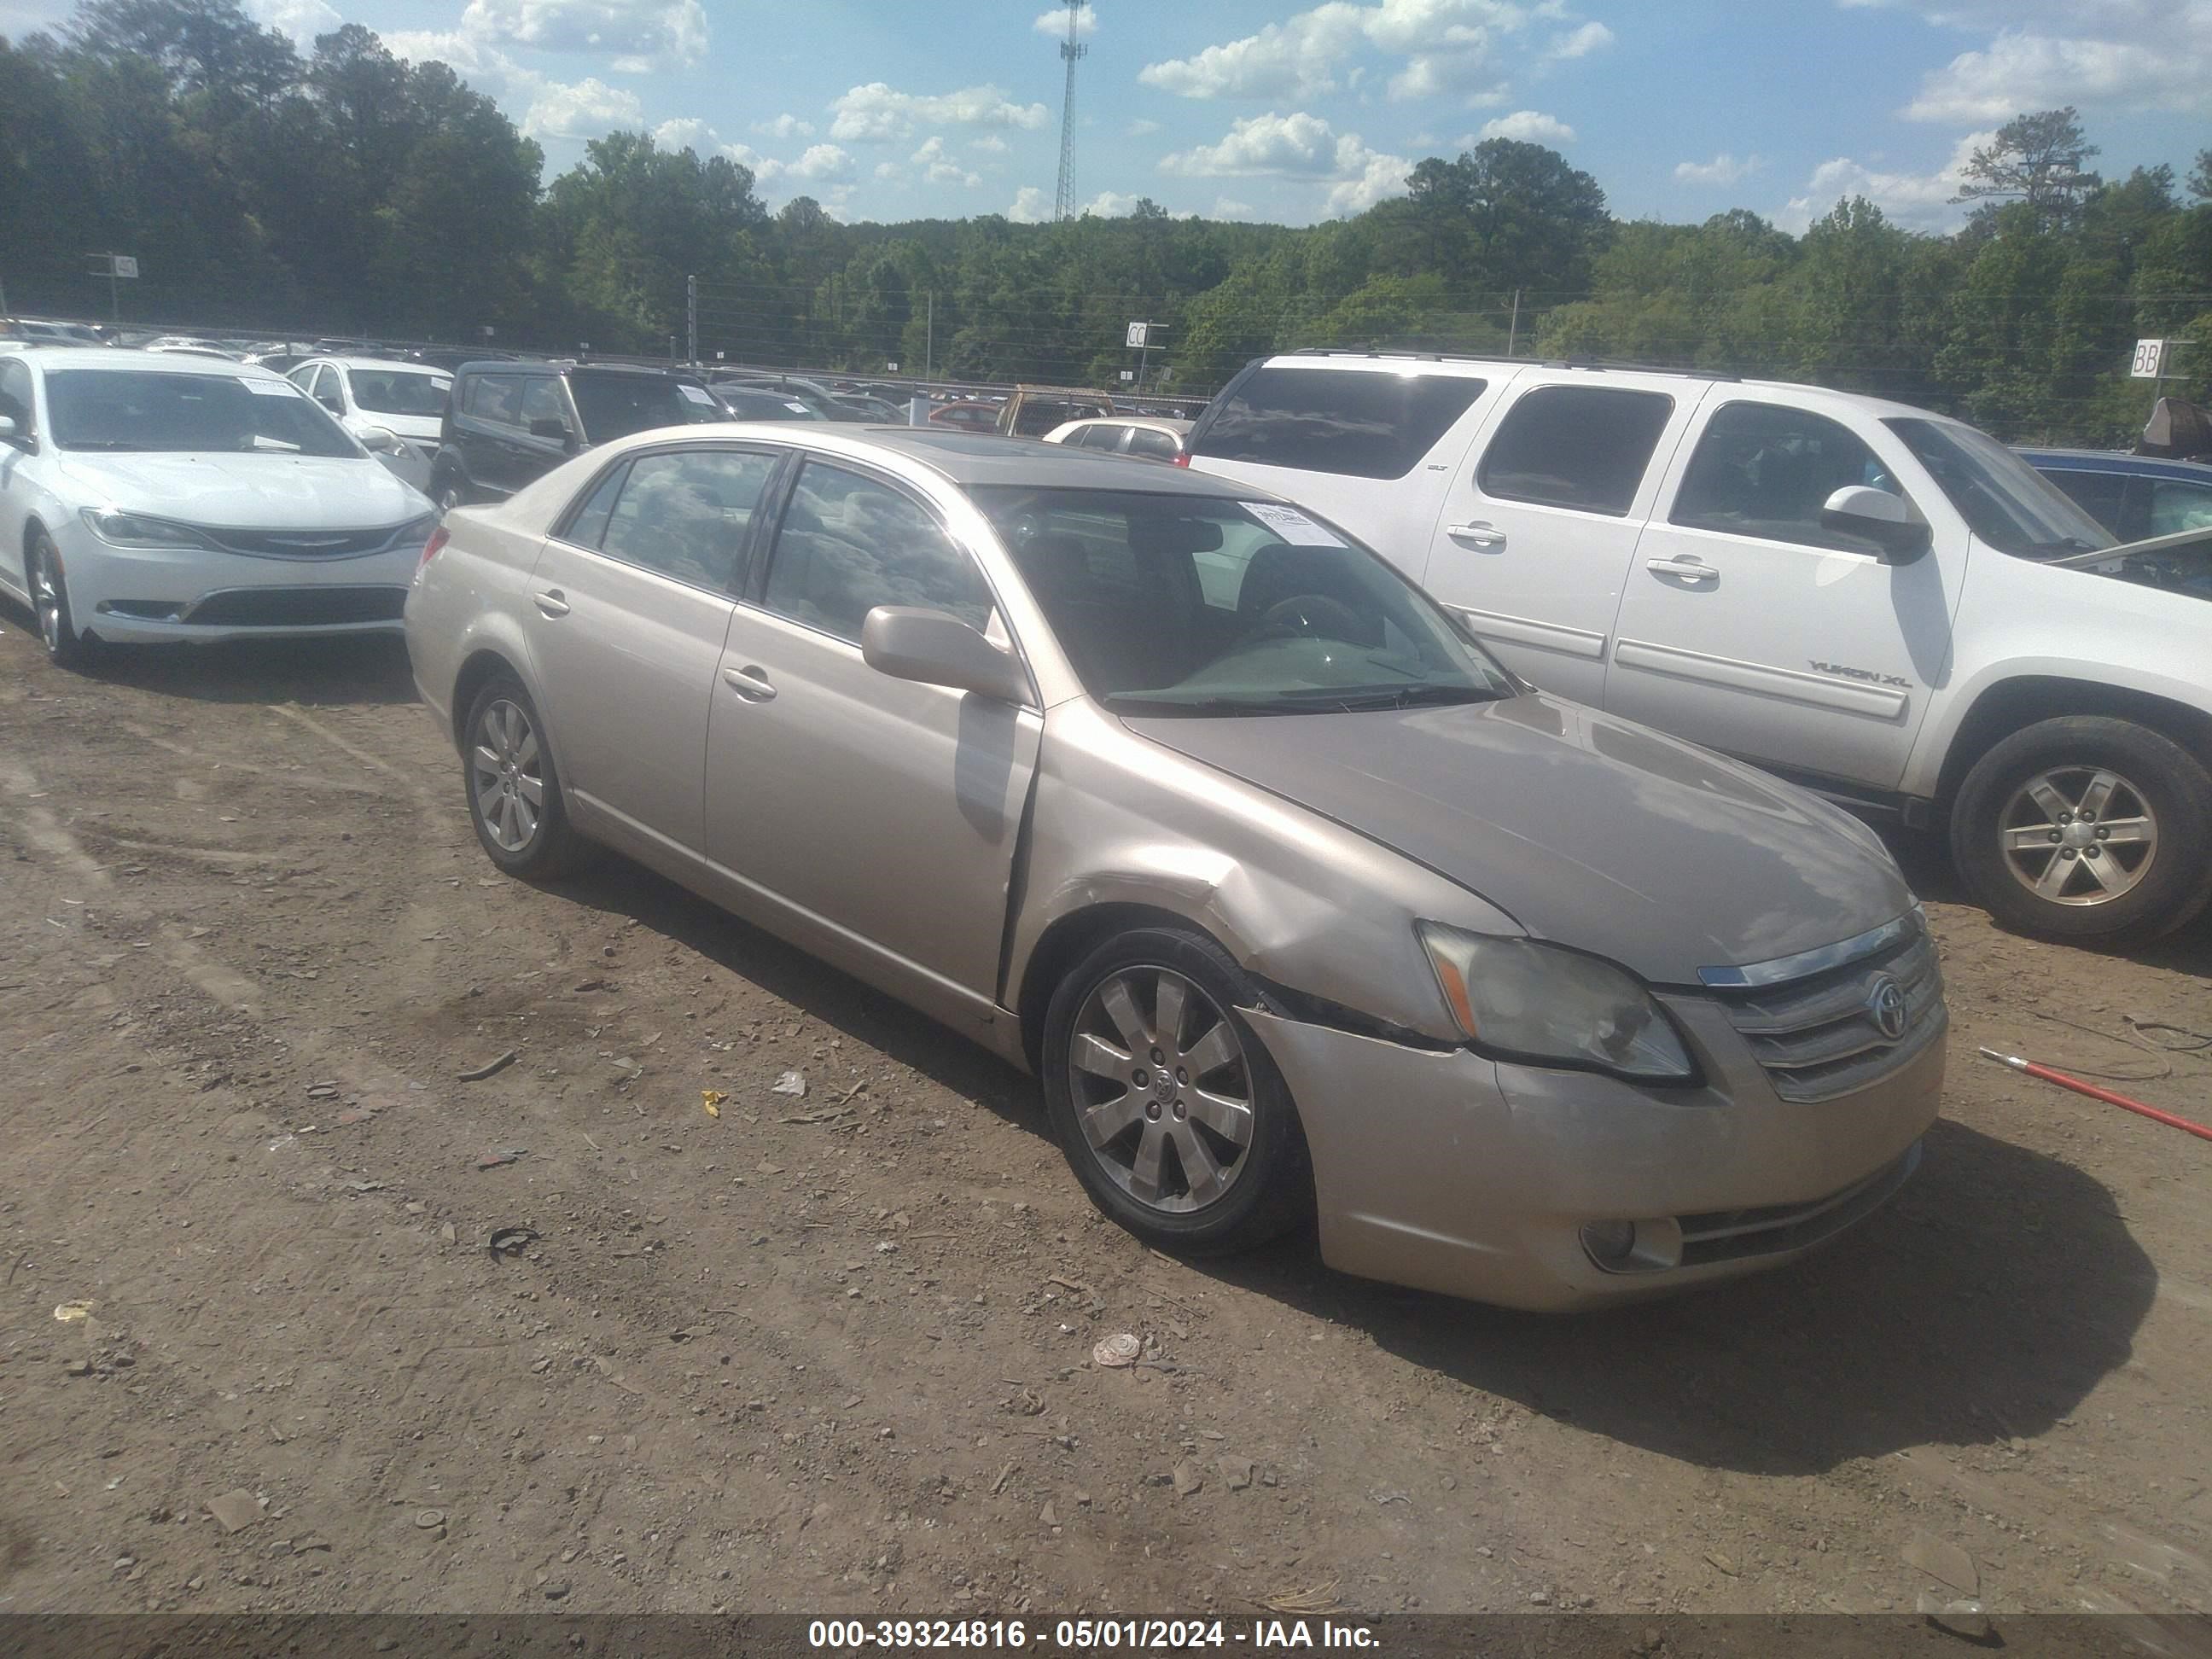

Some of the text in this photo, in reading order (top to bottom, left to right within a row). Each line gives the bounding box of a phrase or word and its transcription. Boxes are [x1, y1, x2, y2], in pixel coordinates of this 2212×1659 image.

[1128, 326, 1145, 345] CC
[2134, 345, 2158, 372] BB
[1808, 661, 1913, 688] YUKON XL
